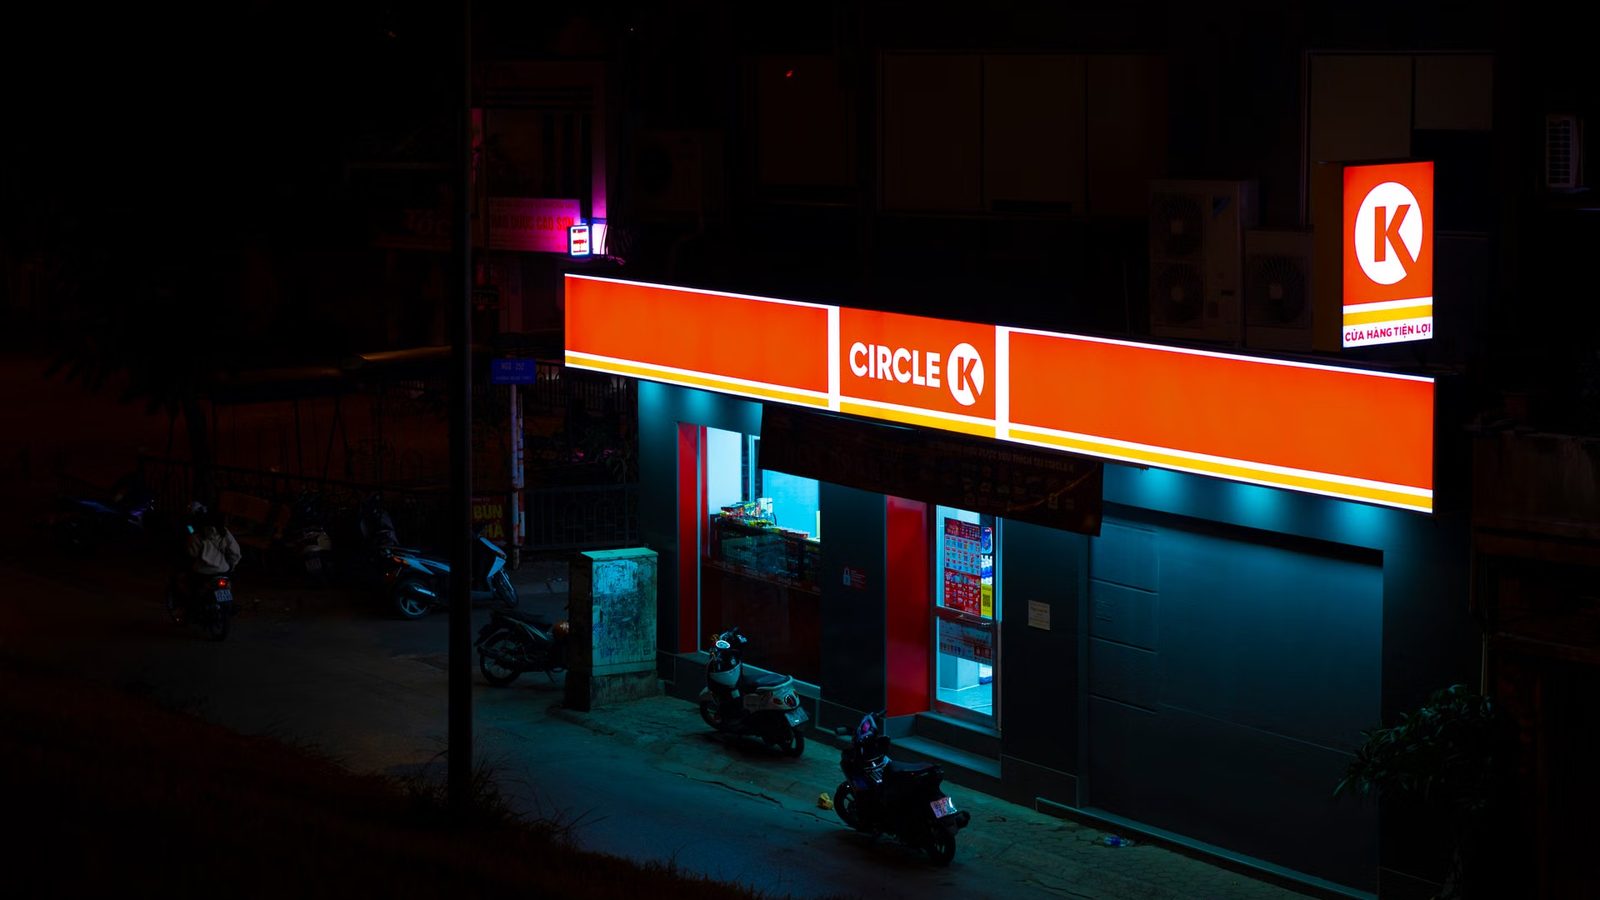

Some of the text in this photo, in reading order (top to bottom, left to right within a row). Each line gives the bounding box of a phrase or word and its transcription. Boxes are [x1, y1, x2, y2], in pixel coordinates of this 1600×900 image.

[1366, 195, 1418, 281] K
[1345, 322, 1431, 342] CỬA HÀNG TIỆN LỢI
[849, 341, 982, 405] CIRCLE K
